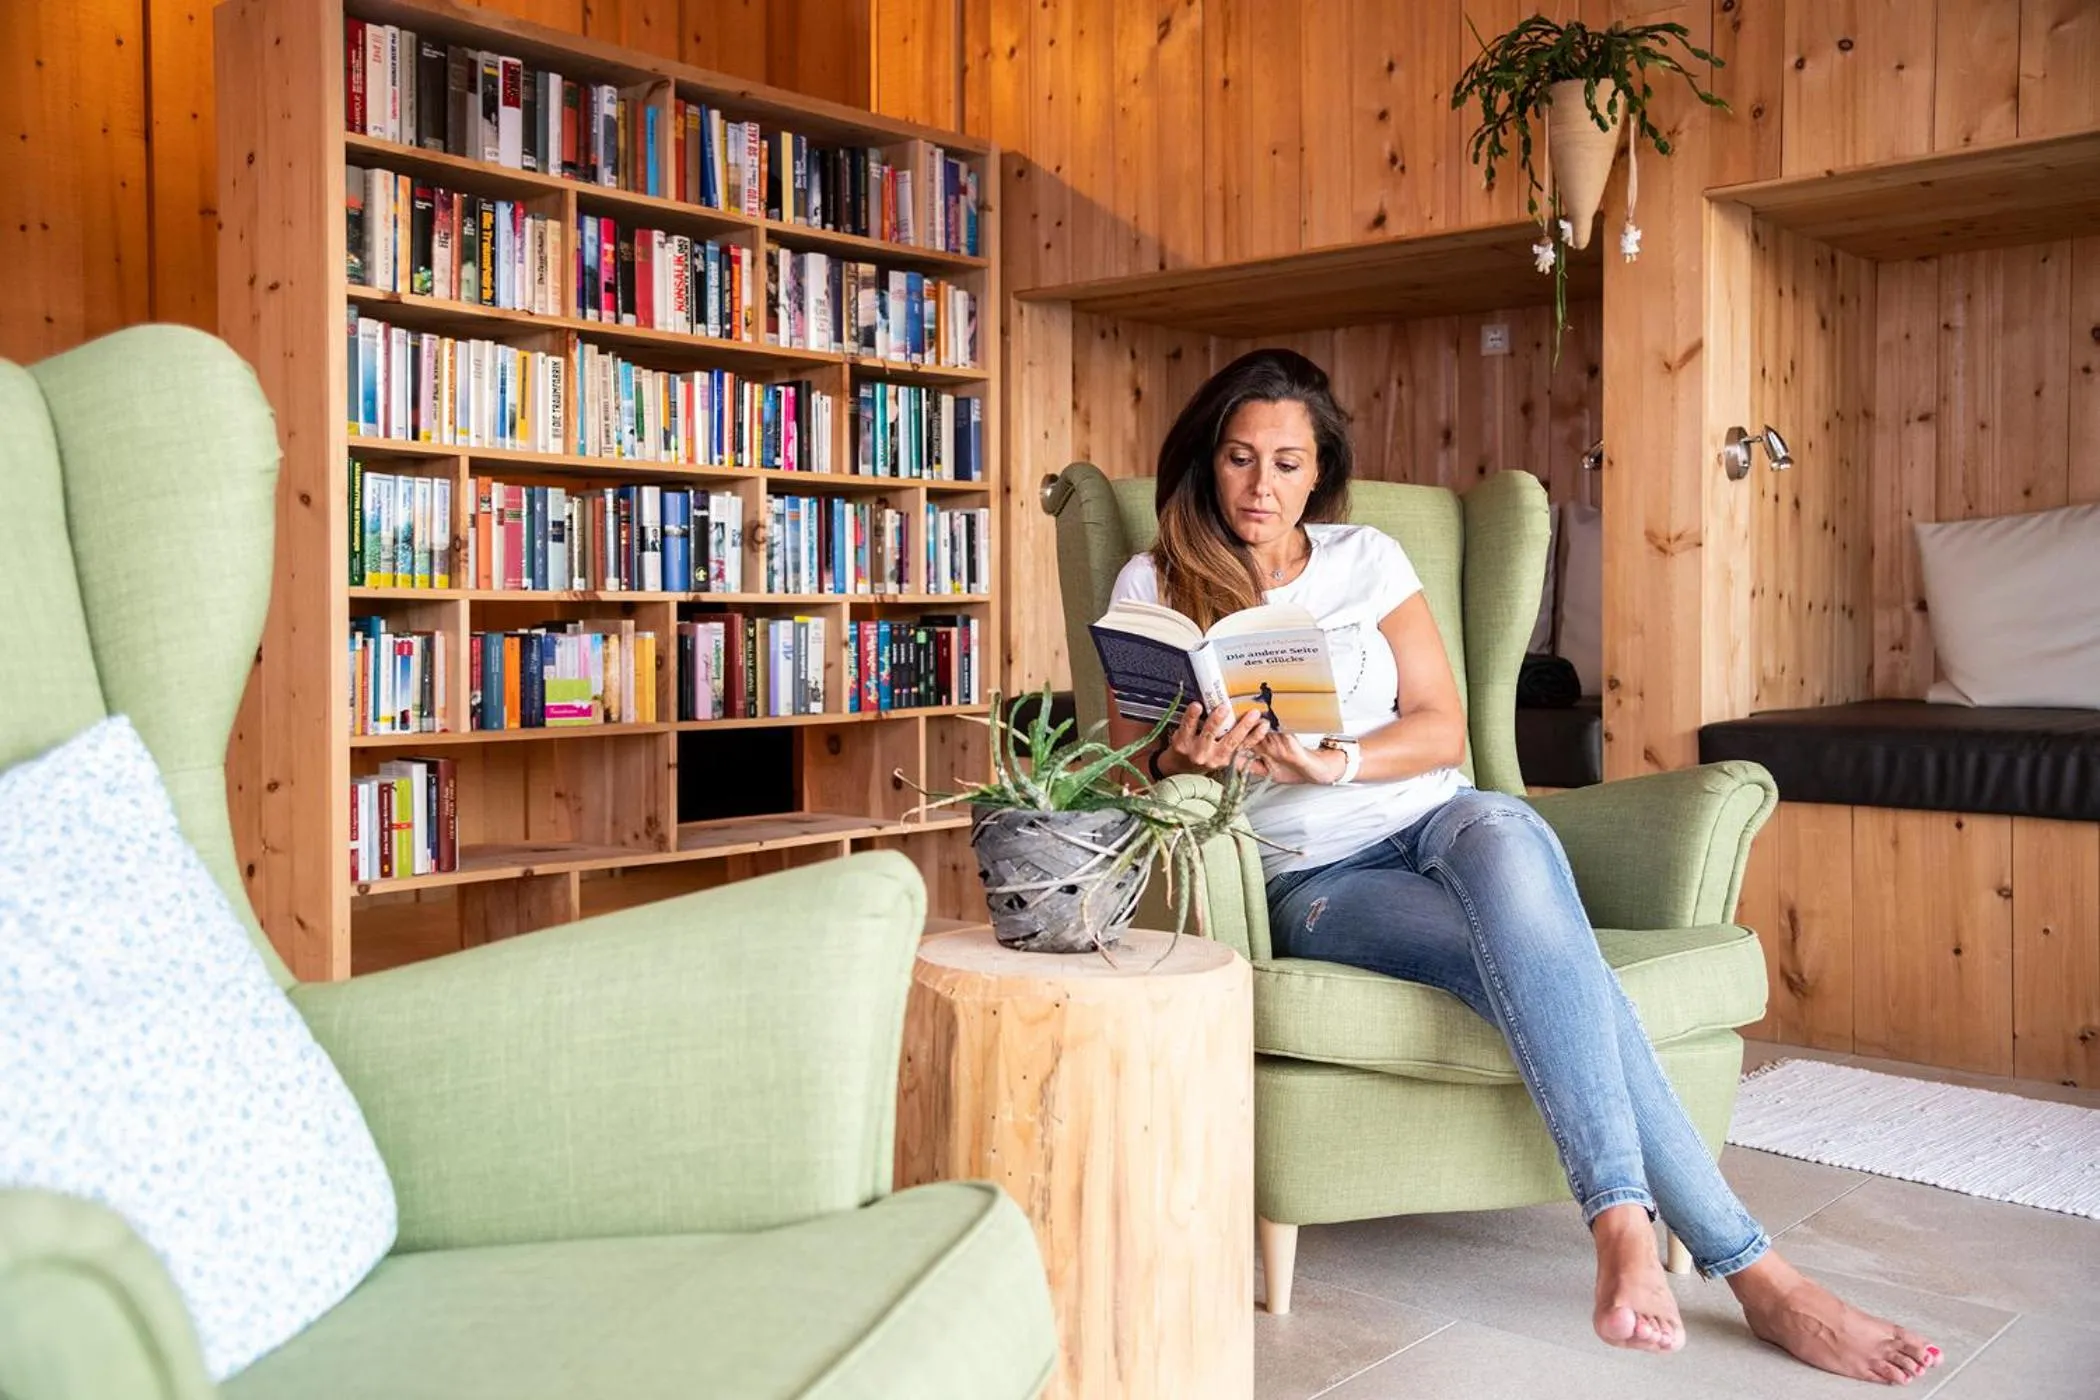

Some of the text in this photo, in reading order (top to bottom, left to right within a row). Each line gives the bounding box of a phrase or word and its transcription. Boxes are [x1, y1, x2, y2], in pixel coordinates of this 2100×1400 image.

[673, 254, 685, 312] KONSALIK
[1225, 646, 1319, 661] Die andere Seite
[1244, 655, 1305, 666] des Glücks
